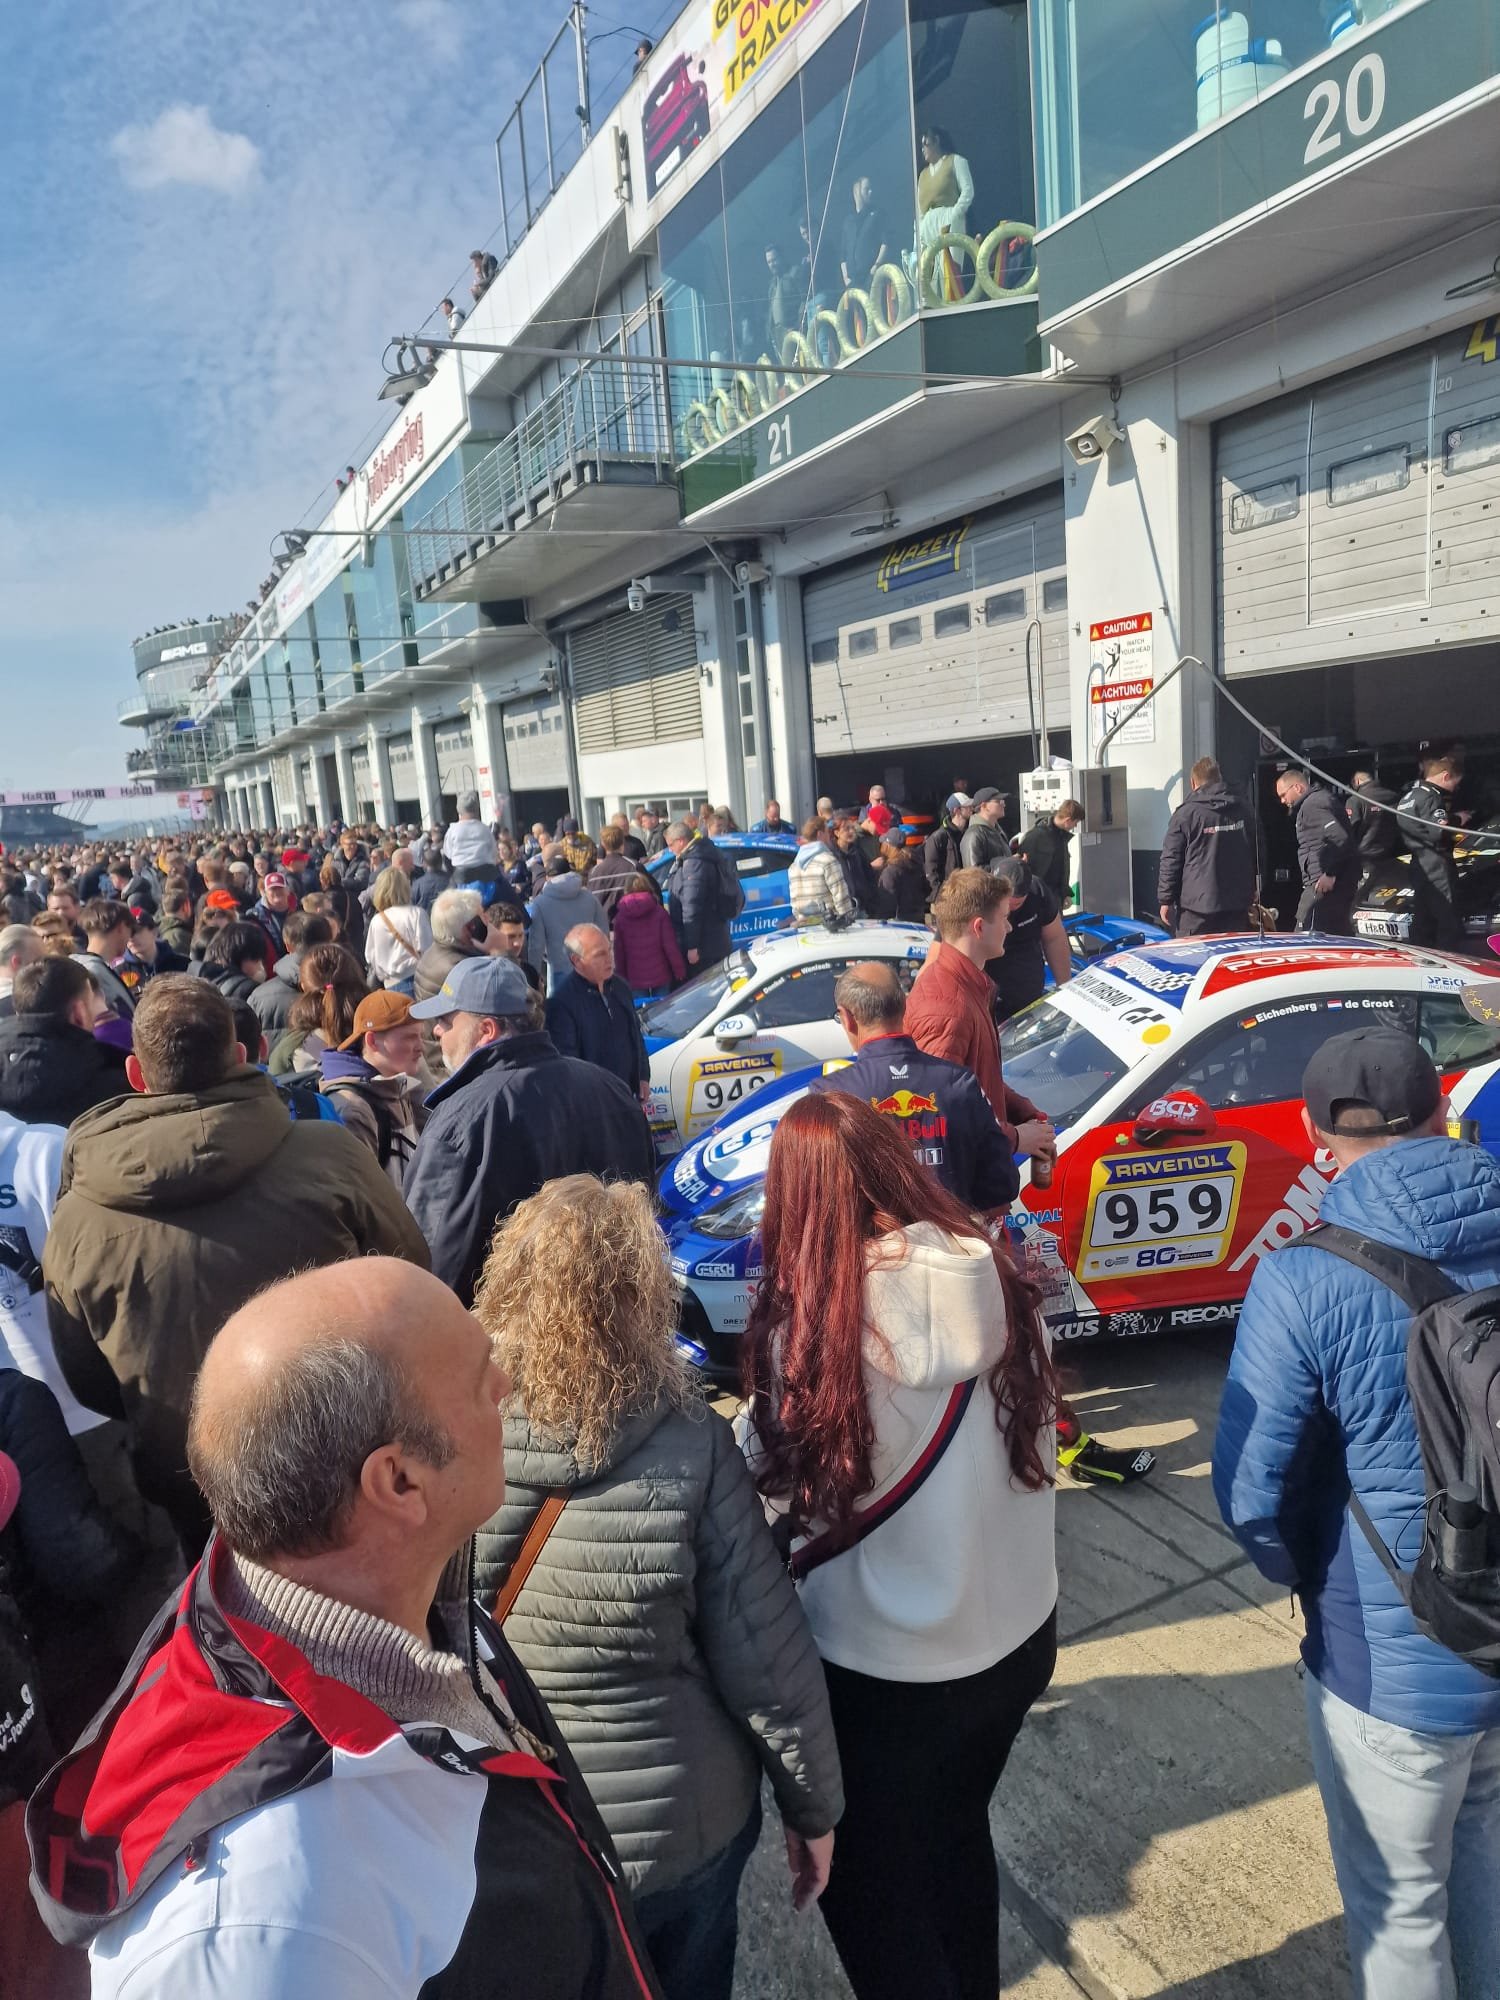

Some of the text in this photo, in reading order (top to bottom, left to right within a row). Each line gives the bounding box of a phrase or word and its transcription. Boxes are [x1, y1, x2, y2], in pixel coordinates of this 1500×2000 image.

[1304, 53, 1385, 164] 20
[1437, 376, 1452, 394] 20
[768, 414, 792, 465] 21
[1103, 619, 1138, 635] CAUTION
[162, 642, 208, 662] AMG
[1101, 683, 1143, 699] ACHTUNG
[730, 916, 779, 935] lus.line
[1086, 982, 1133, 1007] TURISMO
[1345, 999, 1395, 1009] de Groot
[1255, 1002, 1317, 1024] Eichenberg
[705, 1057, 769, 1073] RAVENOL
[650, 1086, 669, 1094] NAL
[908, 1116, 947, 1138] Bull
[1116, 1154, 1225, 1178] RAVENOL
[1005, 1208, 1062, 1228] RONAL
[1105, 1183, 1222, 1240] 959
[1136, 1247, 1176, 1268] 80
